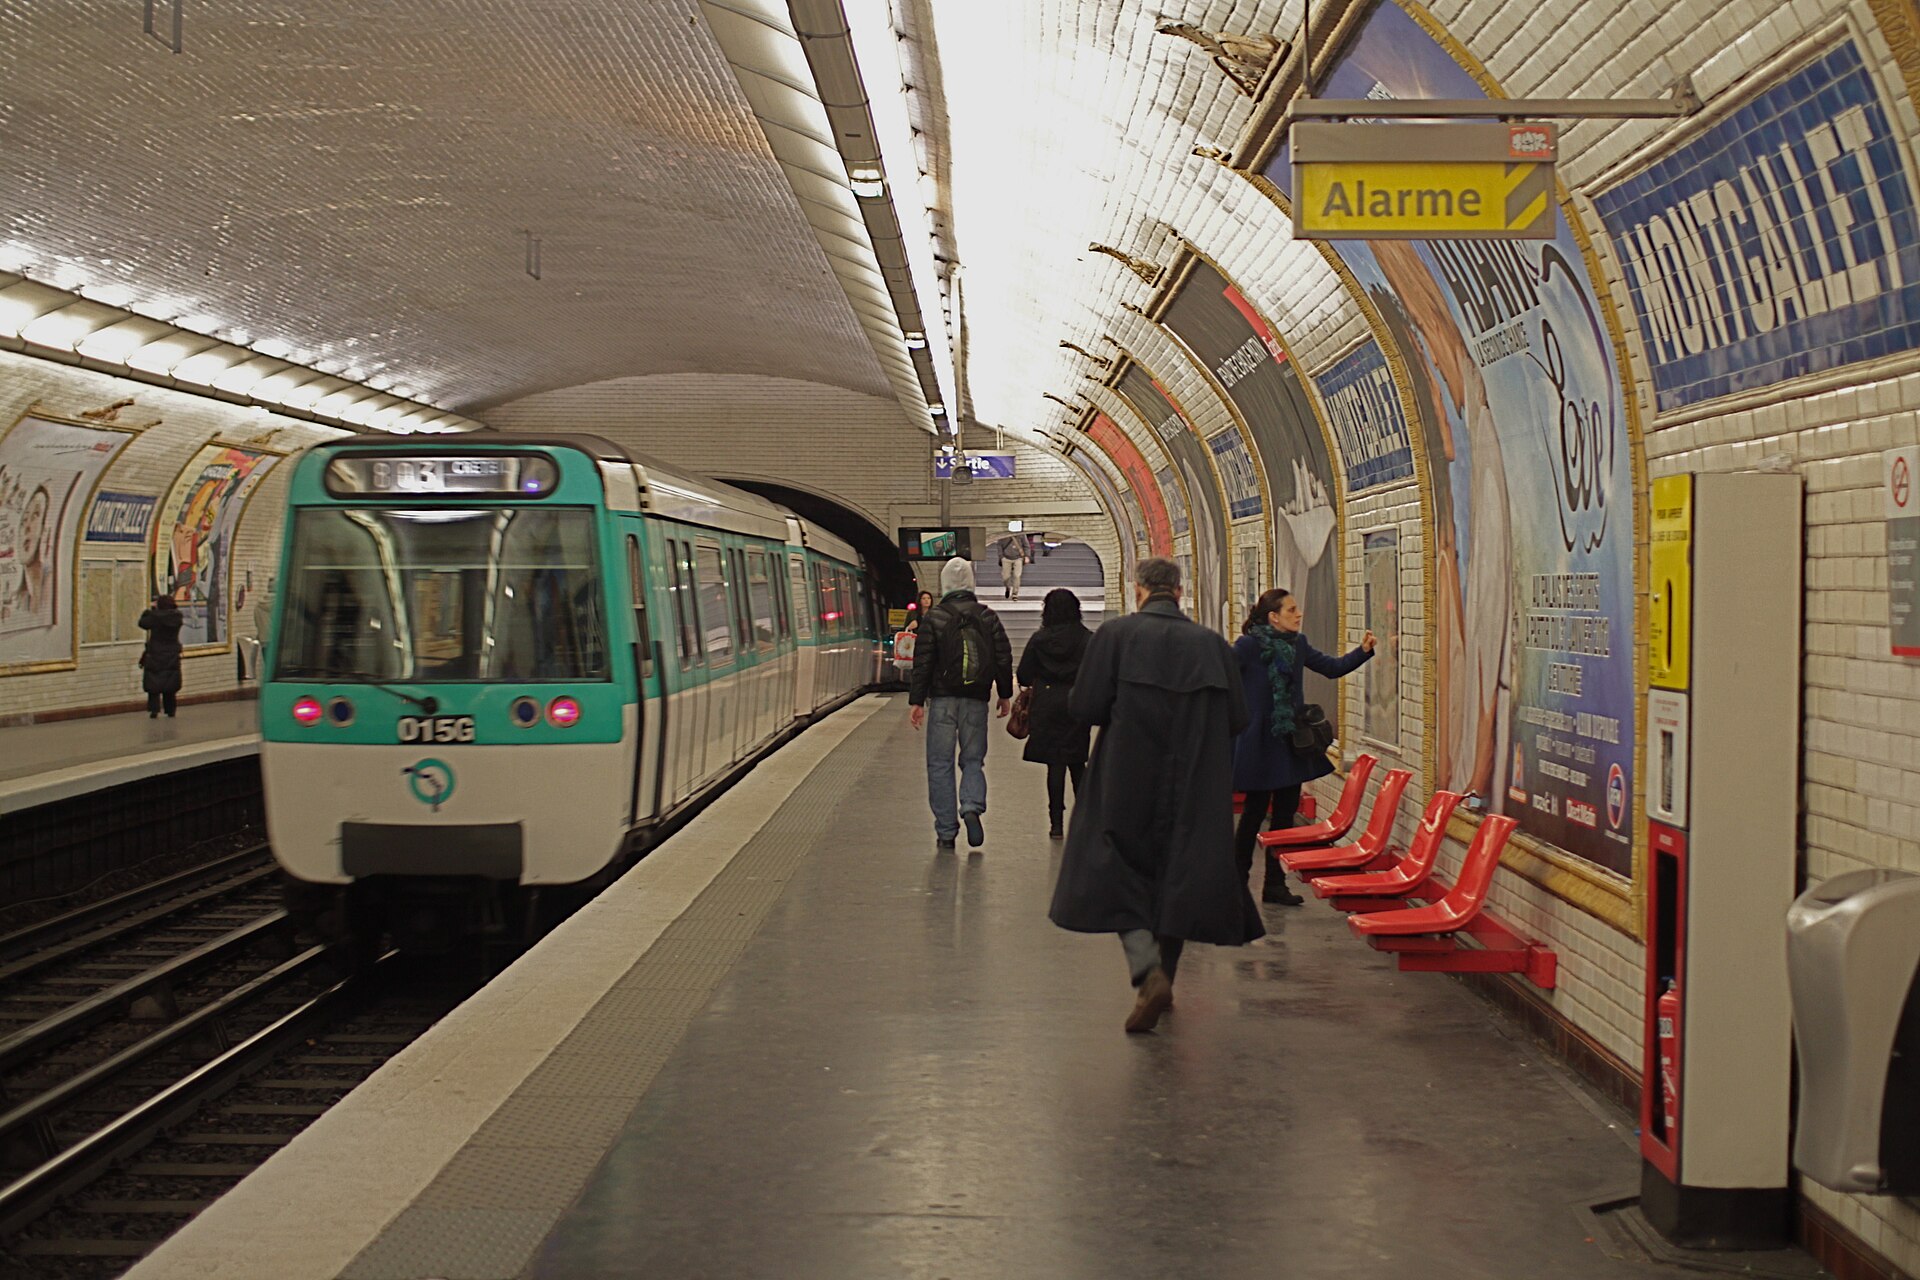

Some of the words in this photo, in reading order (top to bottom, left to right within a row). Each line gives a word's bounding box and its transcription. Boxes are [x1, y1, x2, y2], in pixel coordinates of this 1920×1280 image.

[1322, 179, 1483, 217] Alarme
[1621, 104, 1903, 364] MONTGALLET
[1325, 364, 1410, 470] MONTGALLET
[949, 457, 990, 469] Srtie
[89, 500, 152, 533] MONTGALLET
[398, 716, 475, 743] 015G
